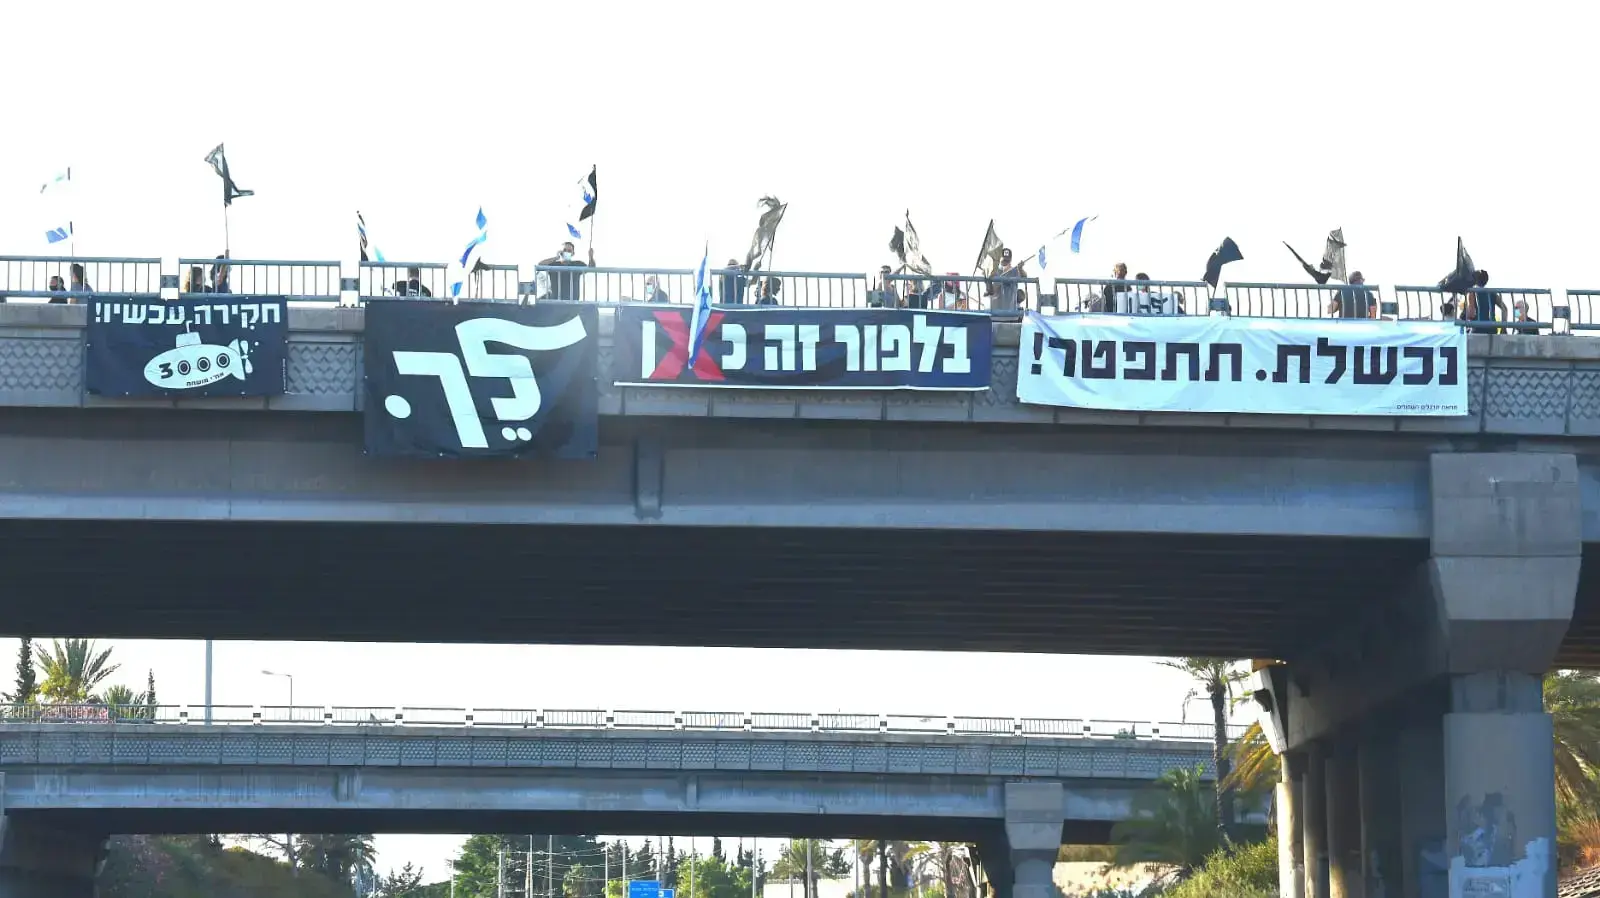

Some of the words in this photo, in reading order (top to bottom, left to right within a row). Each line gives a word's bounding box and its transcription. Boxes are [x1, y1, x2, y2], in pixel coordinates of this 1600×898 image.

[95, 302, 186, 325] עכשיו!
[193, 303, 281, 328] חקירה
[764, 324, 820, 371] זה
[834, 315, 971, 373] בלפור
[1030, 332, 1243, 382] תתפטר!
[1255, 337, 1458, 386] נכשלת.
